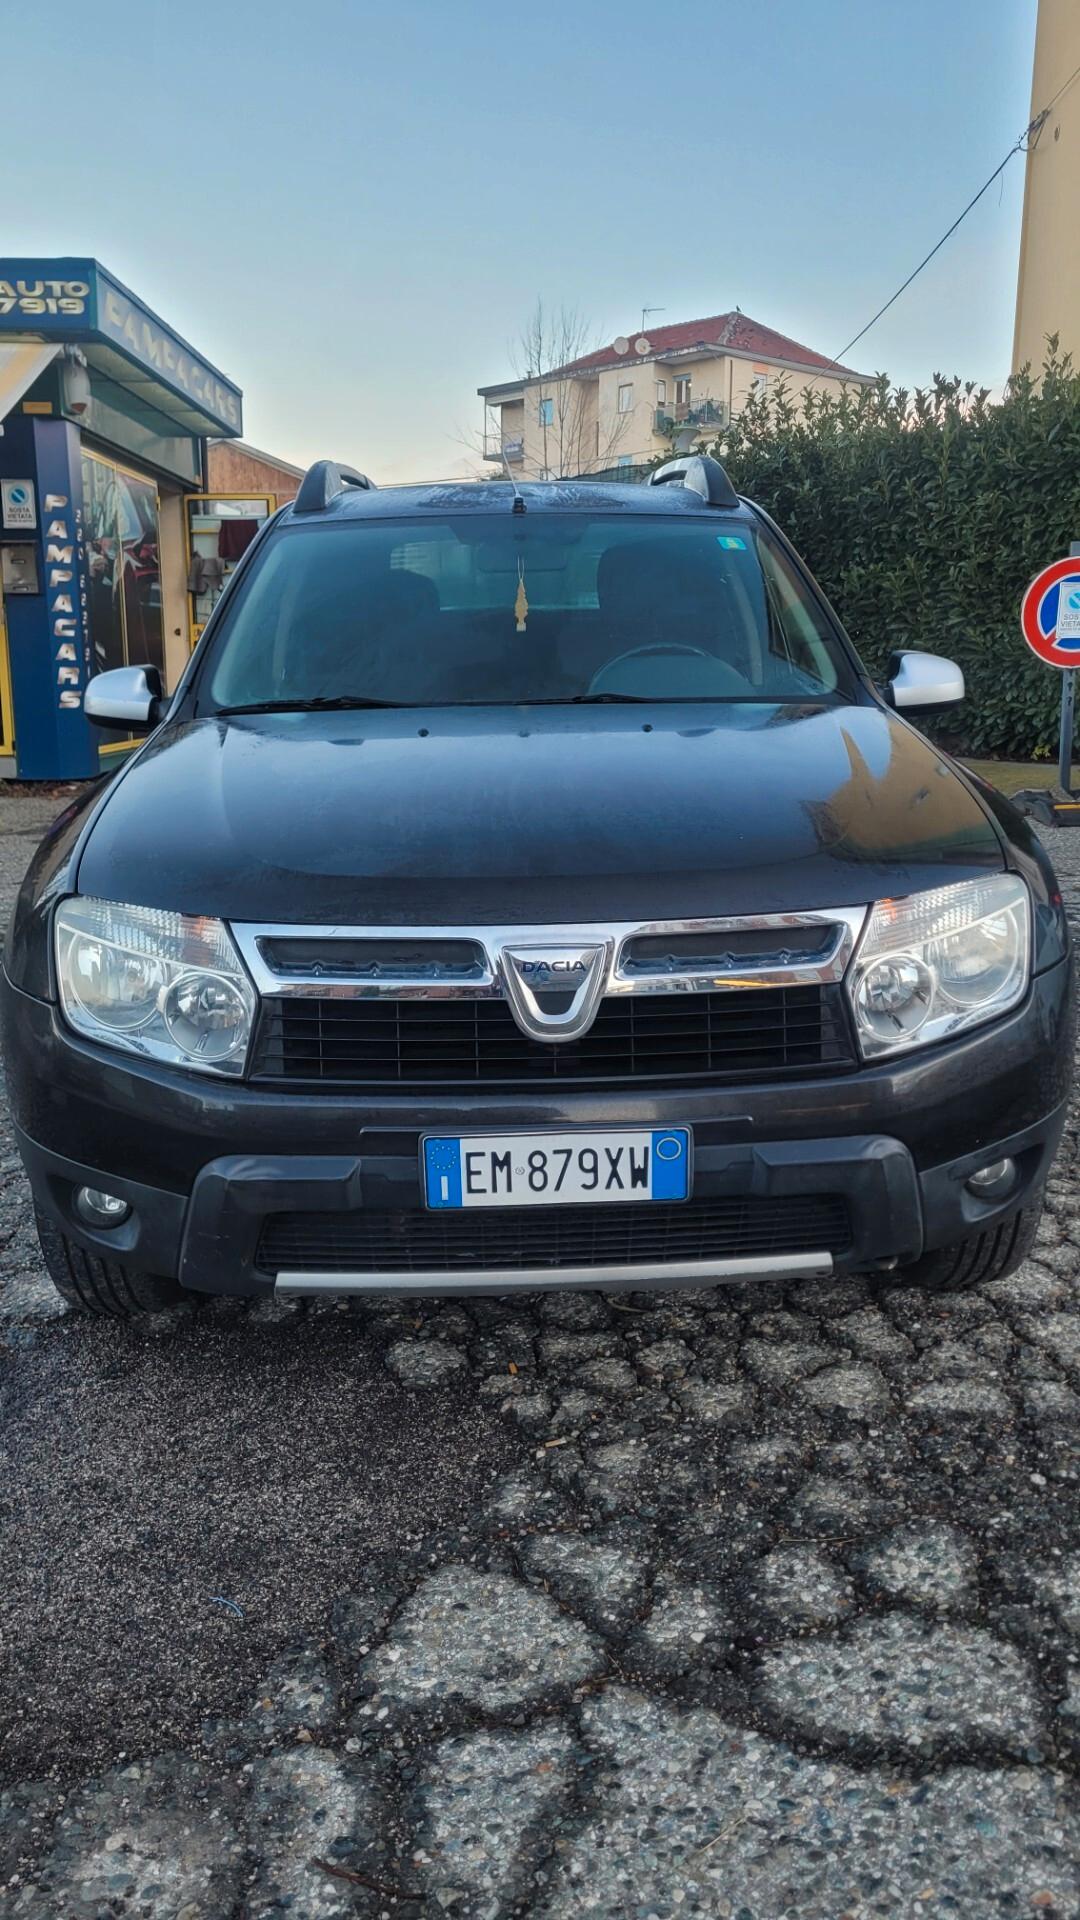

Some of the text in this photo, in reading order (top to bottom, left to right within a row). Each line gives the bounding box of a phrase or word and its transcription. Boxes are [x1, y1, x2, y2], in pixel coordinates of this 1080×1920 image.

[0, 280, 90, 297] AUTO
[0, 298, 85, 315] 7919
[44, 494, 82, 710] PAMPACARS
[521, 960, 586, 974] DACIA
